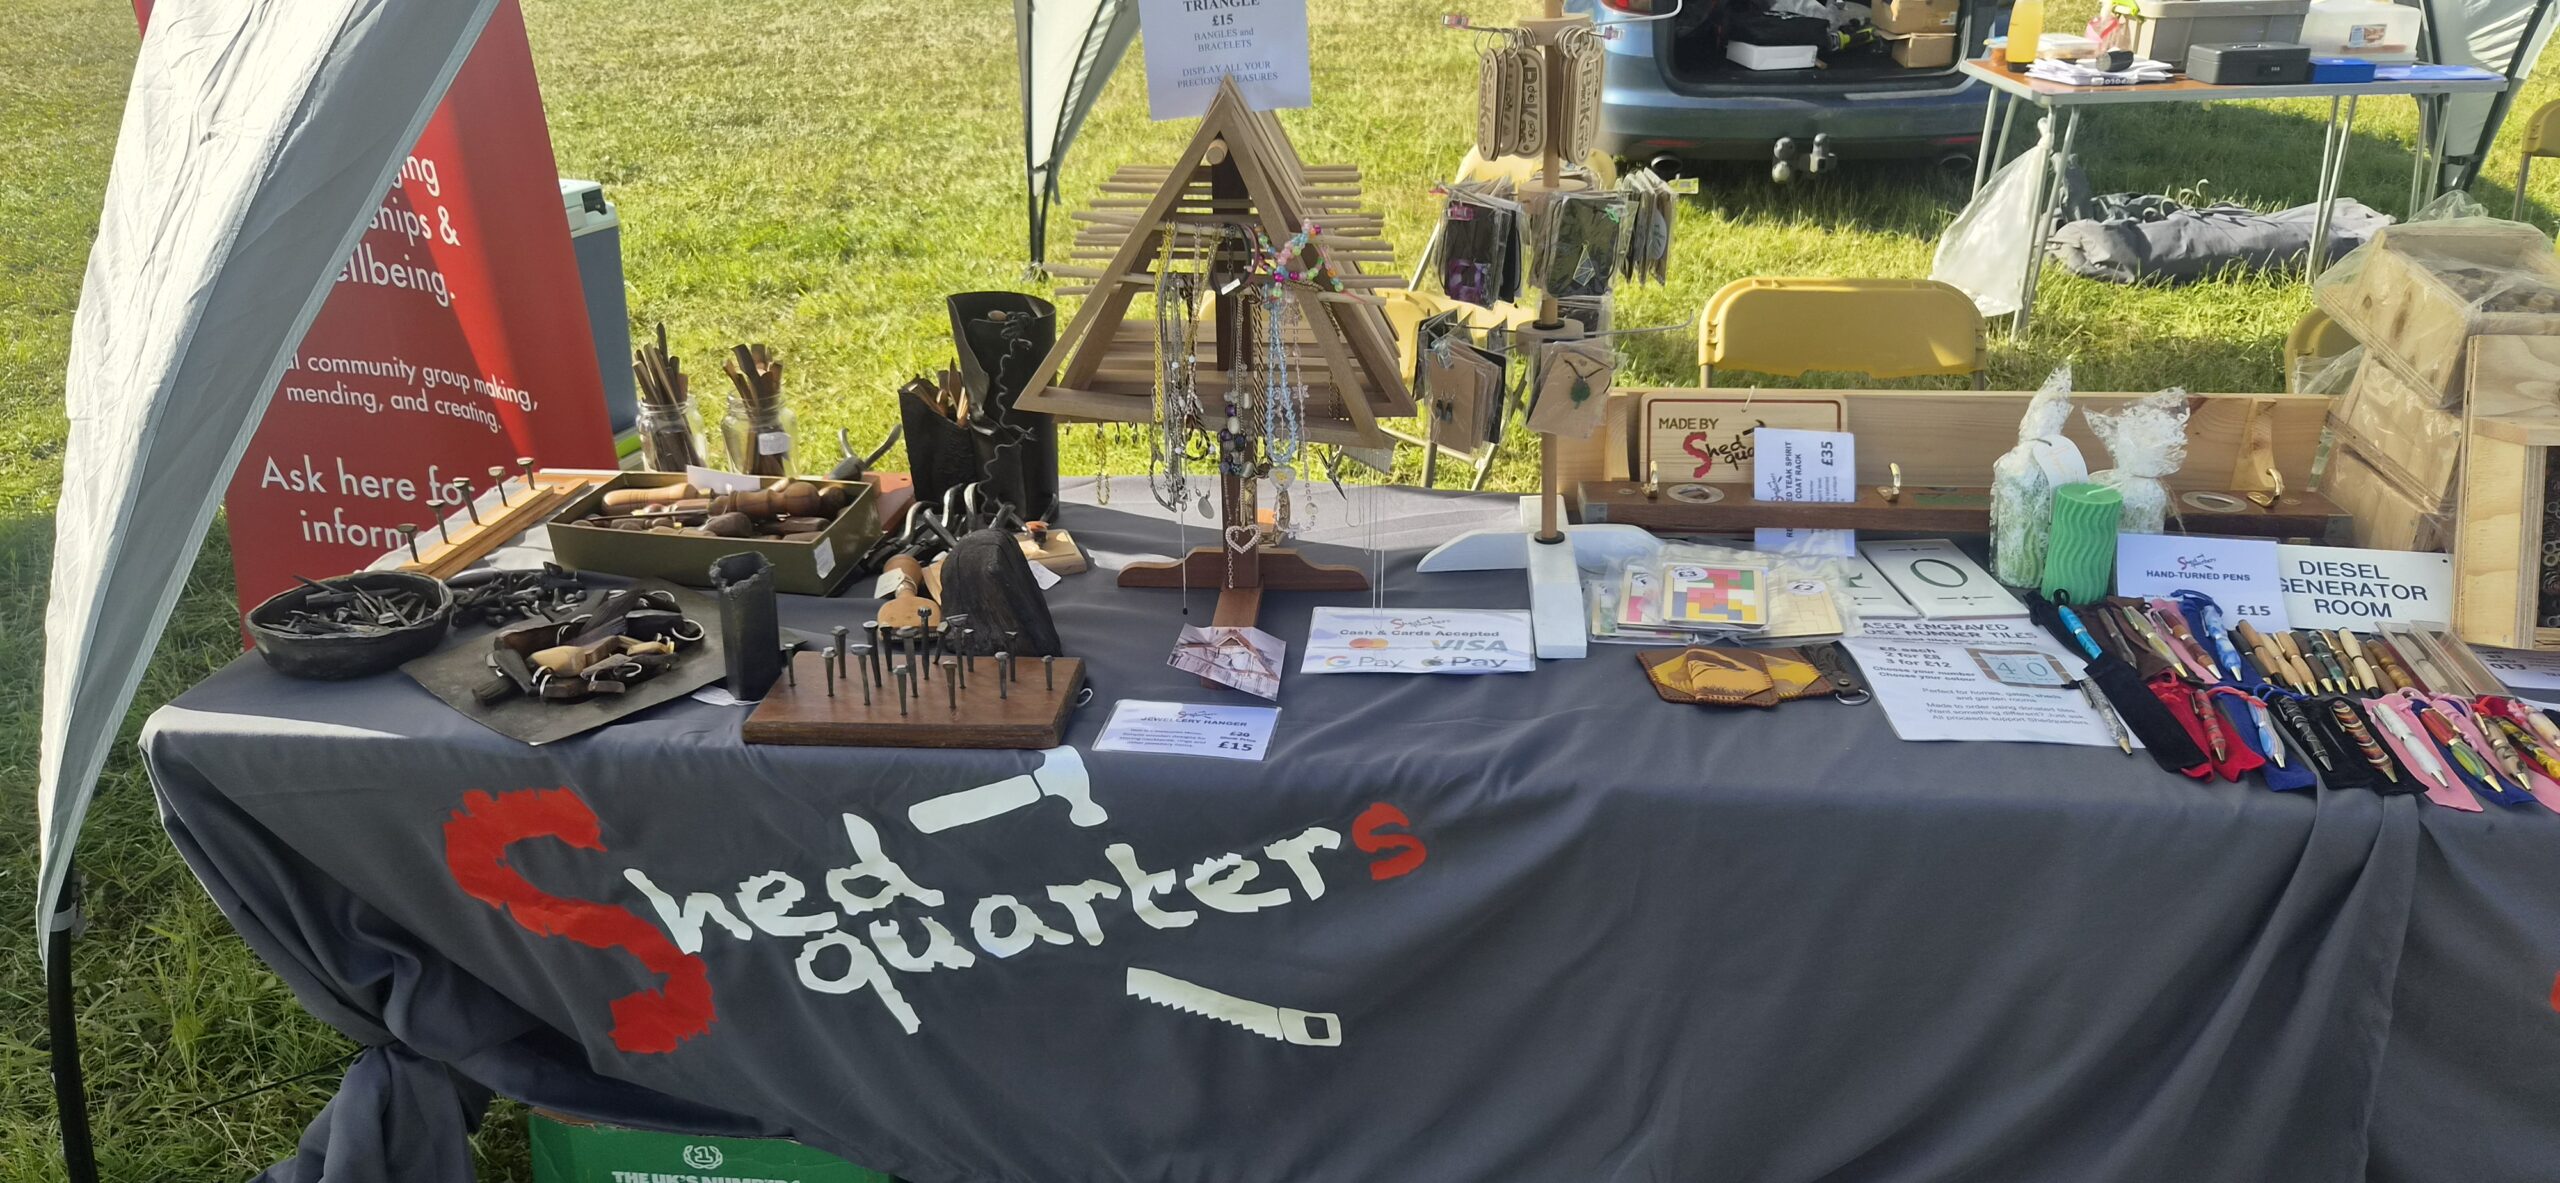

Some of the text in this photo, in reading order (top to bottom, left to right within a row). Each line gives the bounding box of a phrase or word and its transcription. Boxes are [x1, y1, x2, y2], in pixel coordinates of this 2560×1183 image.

[1183, 0, 1260, 12] TRIANGLE
[1212, 14, 1234, 26] £15
[1194, 28, 1254, 41] BANGLES and
[1198, 40, 1252, 52] BRACELETS
[1182, 61, 1271, 77] DISPLAY ALL YOUR
[1177, 77, 1223, 88] PRECIOUS
[438, 205, 461, 246] &
[307, 356, 416, 386] community
[422, 366, 469, 394] group
[473, 374, 538, 412] making,
[286, 381, 502, 433] mending, and creating.
[1659, 418, 1719, 430] MADE BY
[1682, 431, 1747, 479] Shed
[1724, 446, 1754, 470] qua
[1821, 441, 1834, 466] £35
[261, 454, 475, 506] Ask here fo
[299, 507, 424, 549] inform
[1678, 569, 1698, 579] £3
[2146, 570, 2251, 582] HAND-TURNED PENS
[2299, 560, 2390, 580] DIESEL
[2279, 577, 2428, 601] GENERATOR
[2237, 605, 2271, 616] £15
[2314, 599, 2393, 618] ROOM
[1862, 622, 2010, 631] ASER ENGRAVED
[1339, 629, 1500, 638] Cash & Cards Accepted
[1904, 630, 1981, 638] NUMBER
[1431, 639, 1509, 651] VISA
[1358, 656, 1405, 668] Pay
[1451, 656, 1508, 668] Pay
[1997, 662, 2016, 675] 4
[1141, 716, 1248, 727] JEWELLERY HANGER
[1218, 742, 1253, 752] £15
[443, 786, 944, 1054] Shed
[795, 801, 1425, 1035] quarters
[611, 1171, 649, 1183] THE
